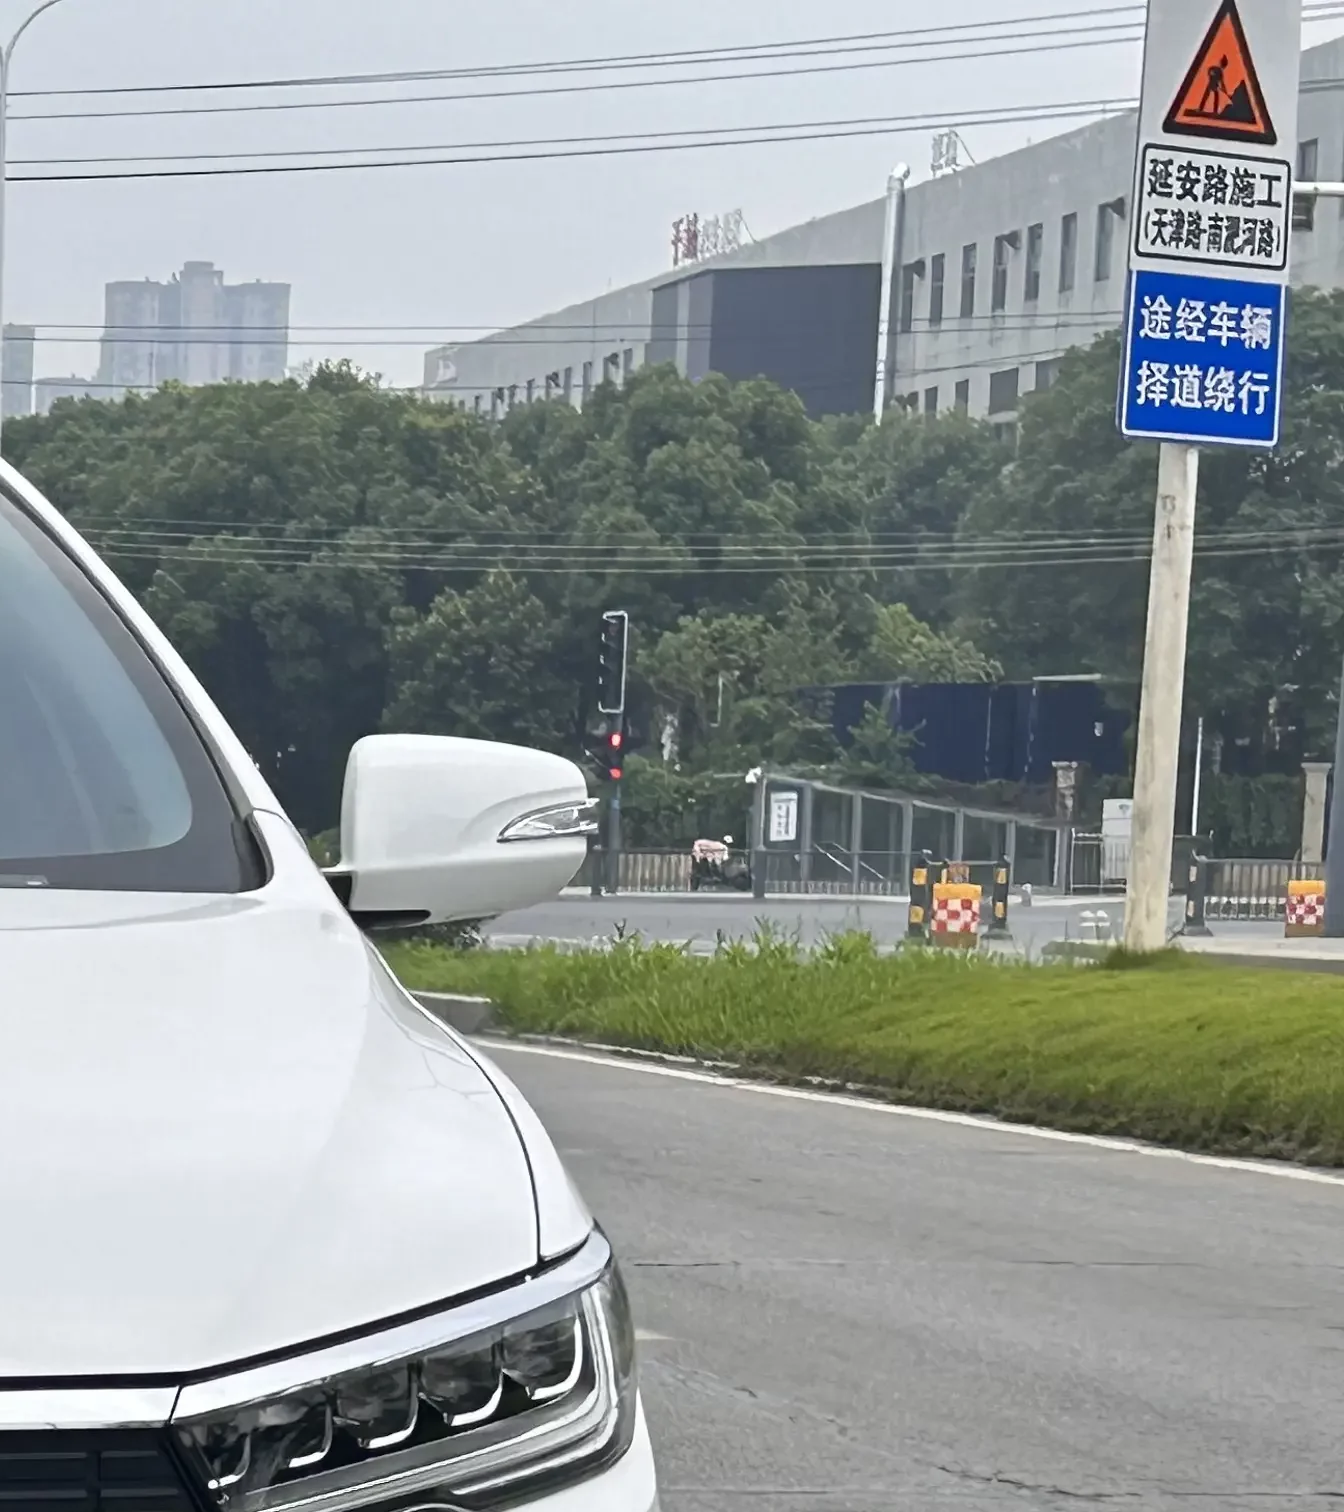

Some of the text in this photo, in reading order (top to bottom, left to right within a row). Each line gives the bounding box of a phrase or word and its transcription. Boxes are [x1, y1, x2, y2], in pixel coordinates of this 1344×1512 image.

[1147, 158, 1282, 208] 延安路施工
[1139, 294, 1272, 350] 途经车辆
[1136, 360, 1270, 415] 择道绕行
